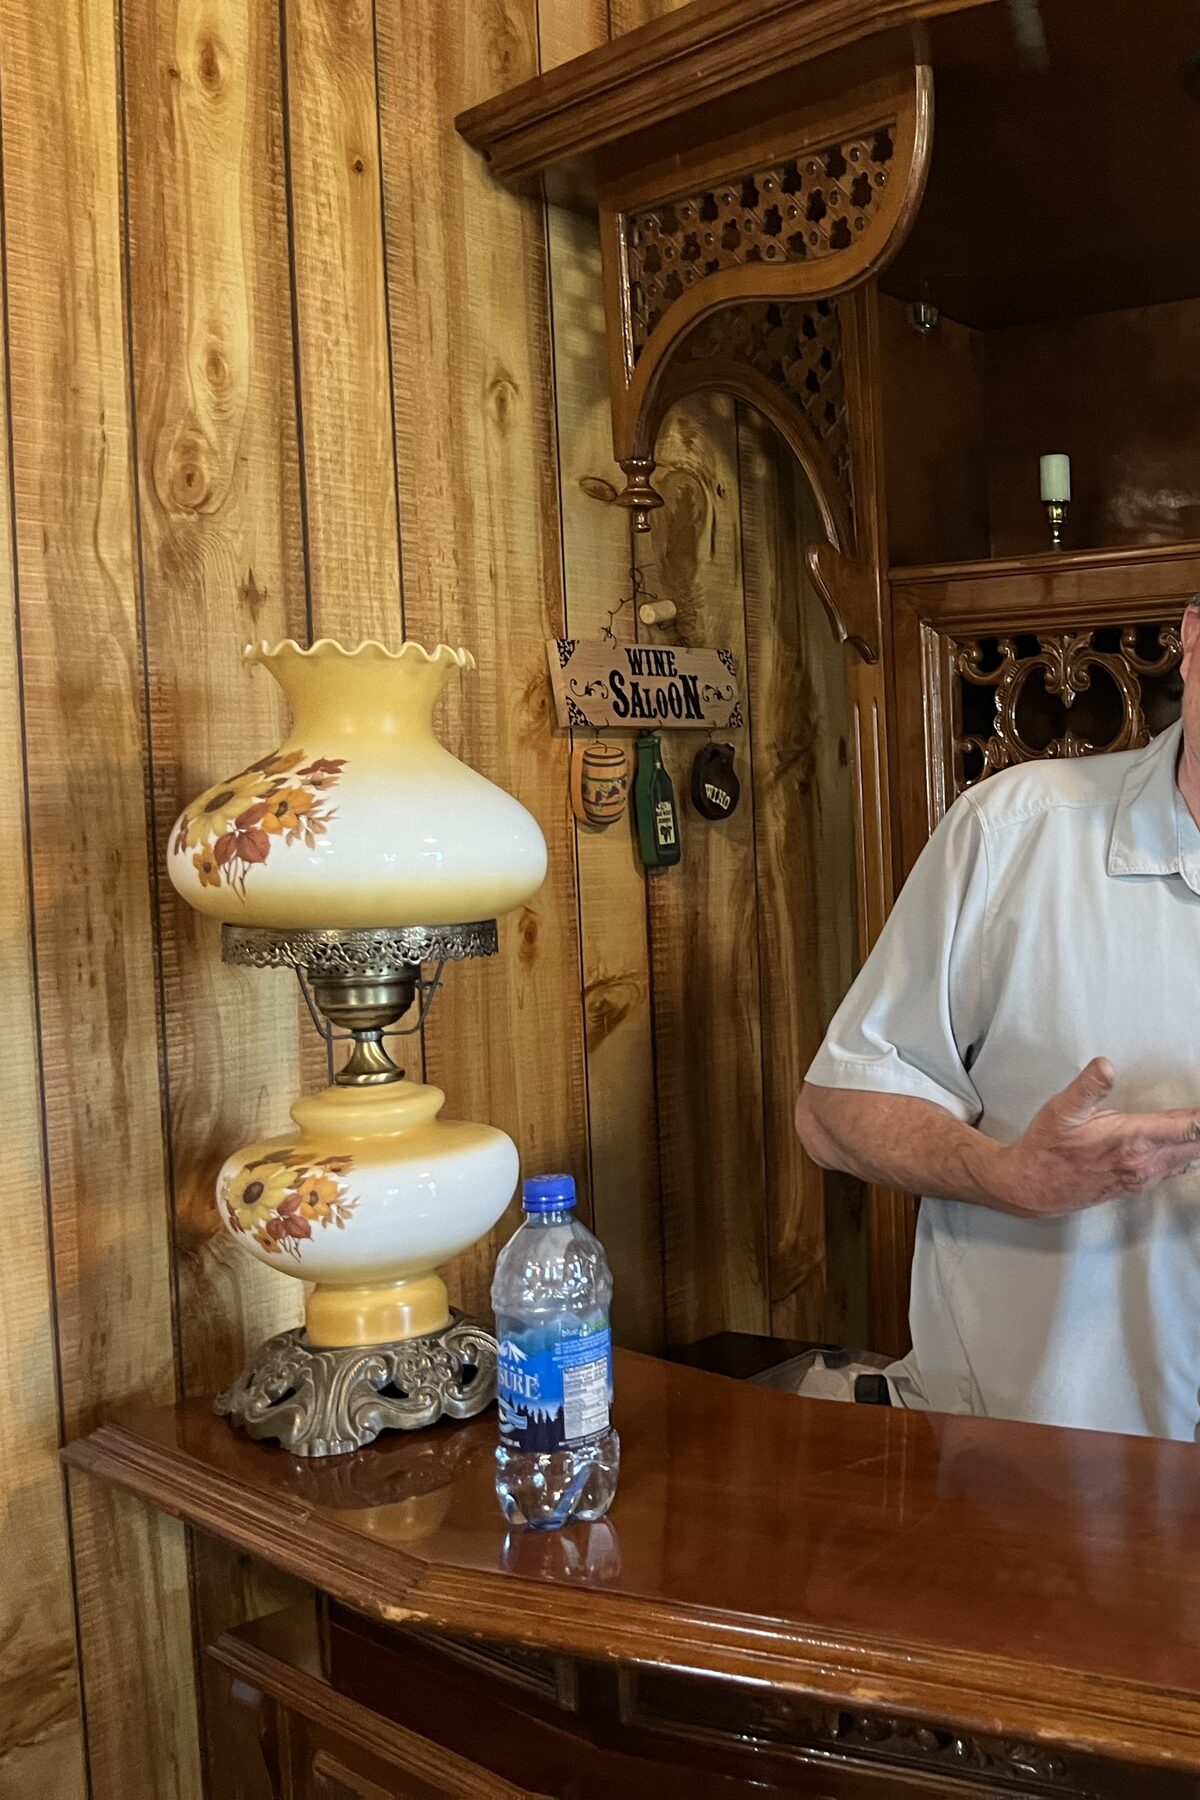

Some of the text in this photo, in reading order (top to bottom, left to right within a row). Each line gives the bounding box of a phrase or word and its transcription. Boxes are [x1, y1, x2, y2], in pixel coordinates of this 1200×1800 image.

[624, 648, 678, 677] WINE
[608, 669, 705, 720] SALOON
[704, 783, 731, 810] WINO
